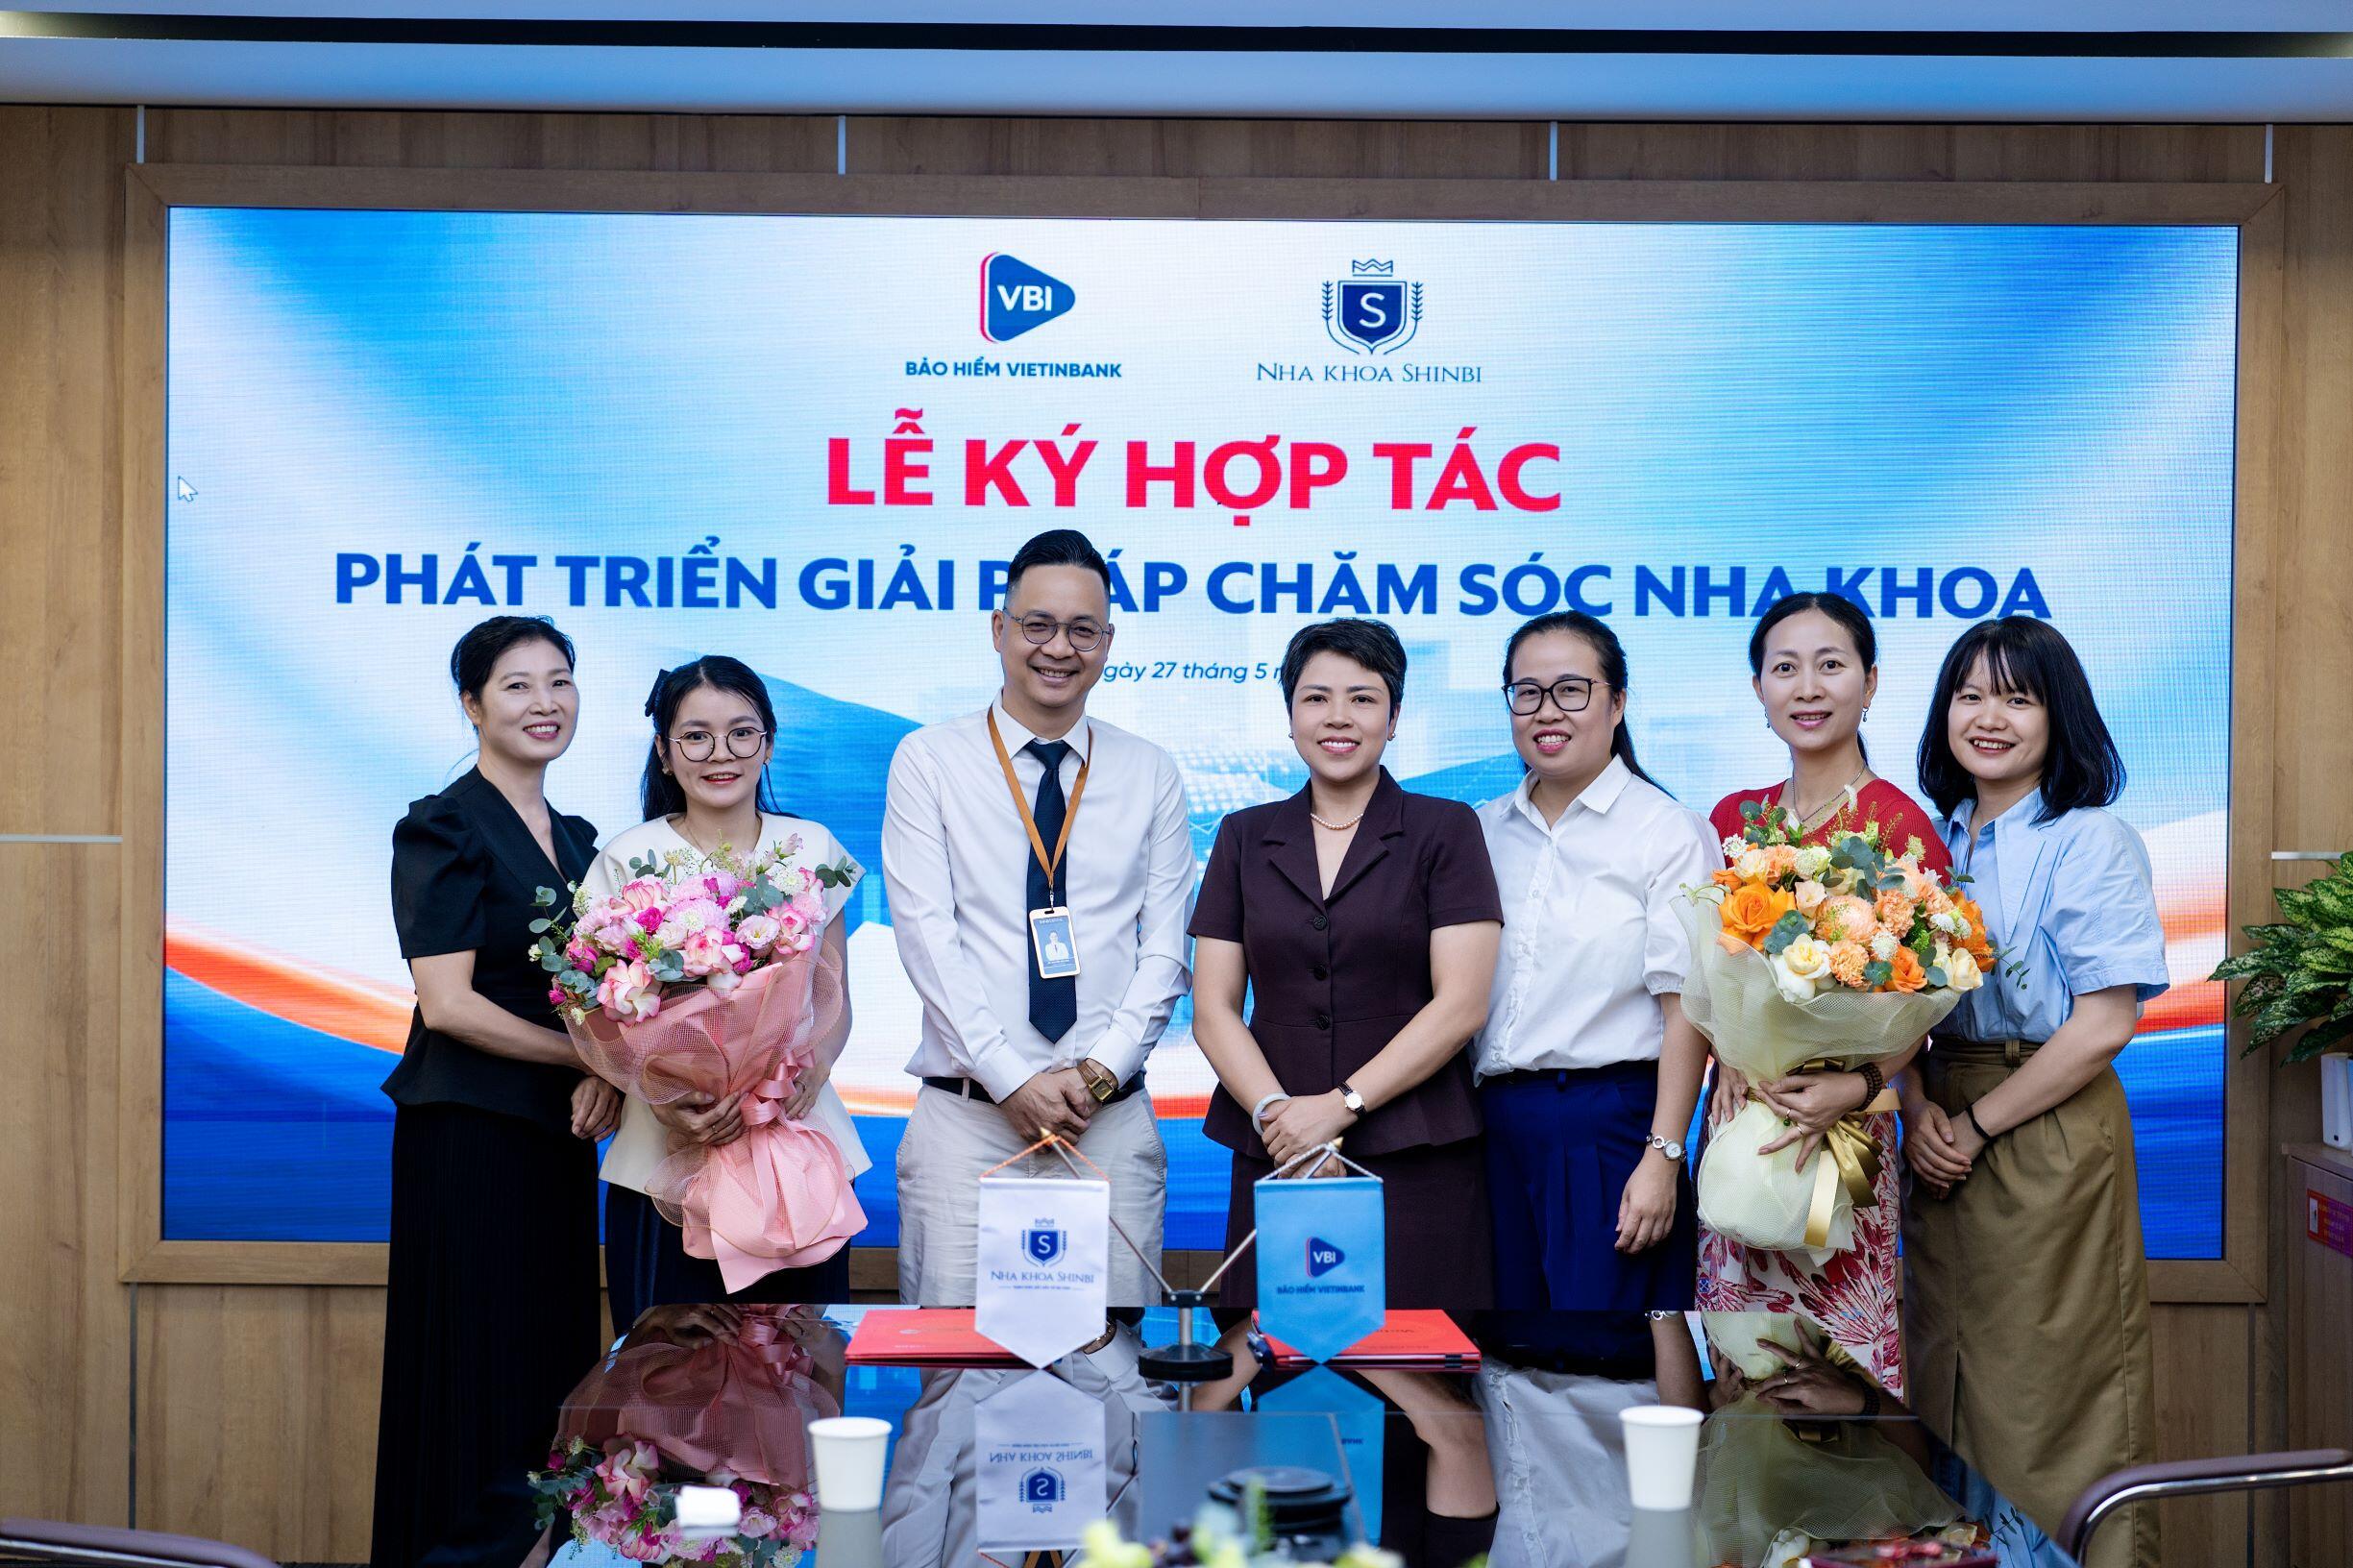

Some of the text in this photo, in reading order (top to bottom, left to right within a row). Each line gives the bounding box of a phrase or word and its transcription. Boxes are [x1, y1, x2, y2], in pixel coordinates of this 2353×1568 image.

[996, 285, 1053, 311] VBI
[1359, 292, 1386, 328] S
[905, 355, 1122, 377] BẢO HIỂM VIETINBANK
[1257, 362, 1482, 382] NHA KHOA SHINBI
[828, 407, 1561, 527] LỄ KÝ HỢP TÁC
[336, 535, 2052, 619] PHÁT TRIỂN GIẢI PÁP CHĂM SÓC NHA KHOA
[1104, 662, 1146, 683] gày
[1151, 661, 1177, 678] 27
[1183, 662, 1248, 684] tháng
[1255, 663, 1268, 679] 5
[1312, 1251, 1336, 1263] VBI
[991, 1270, 1094, 1284] NHA KHOA SHINBI
